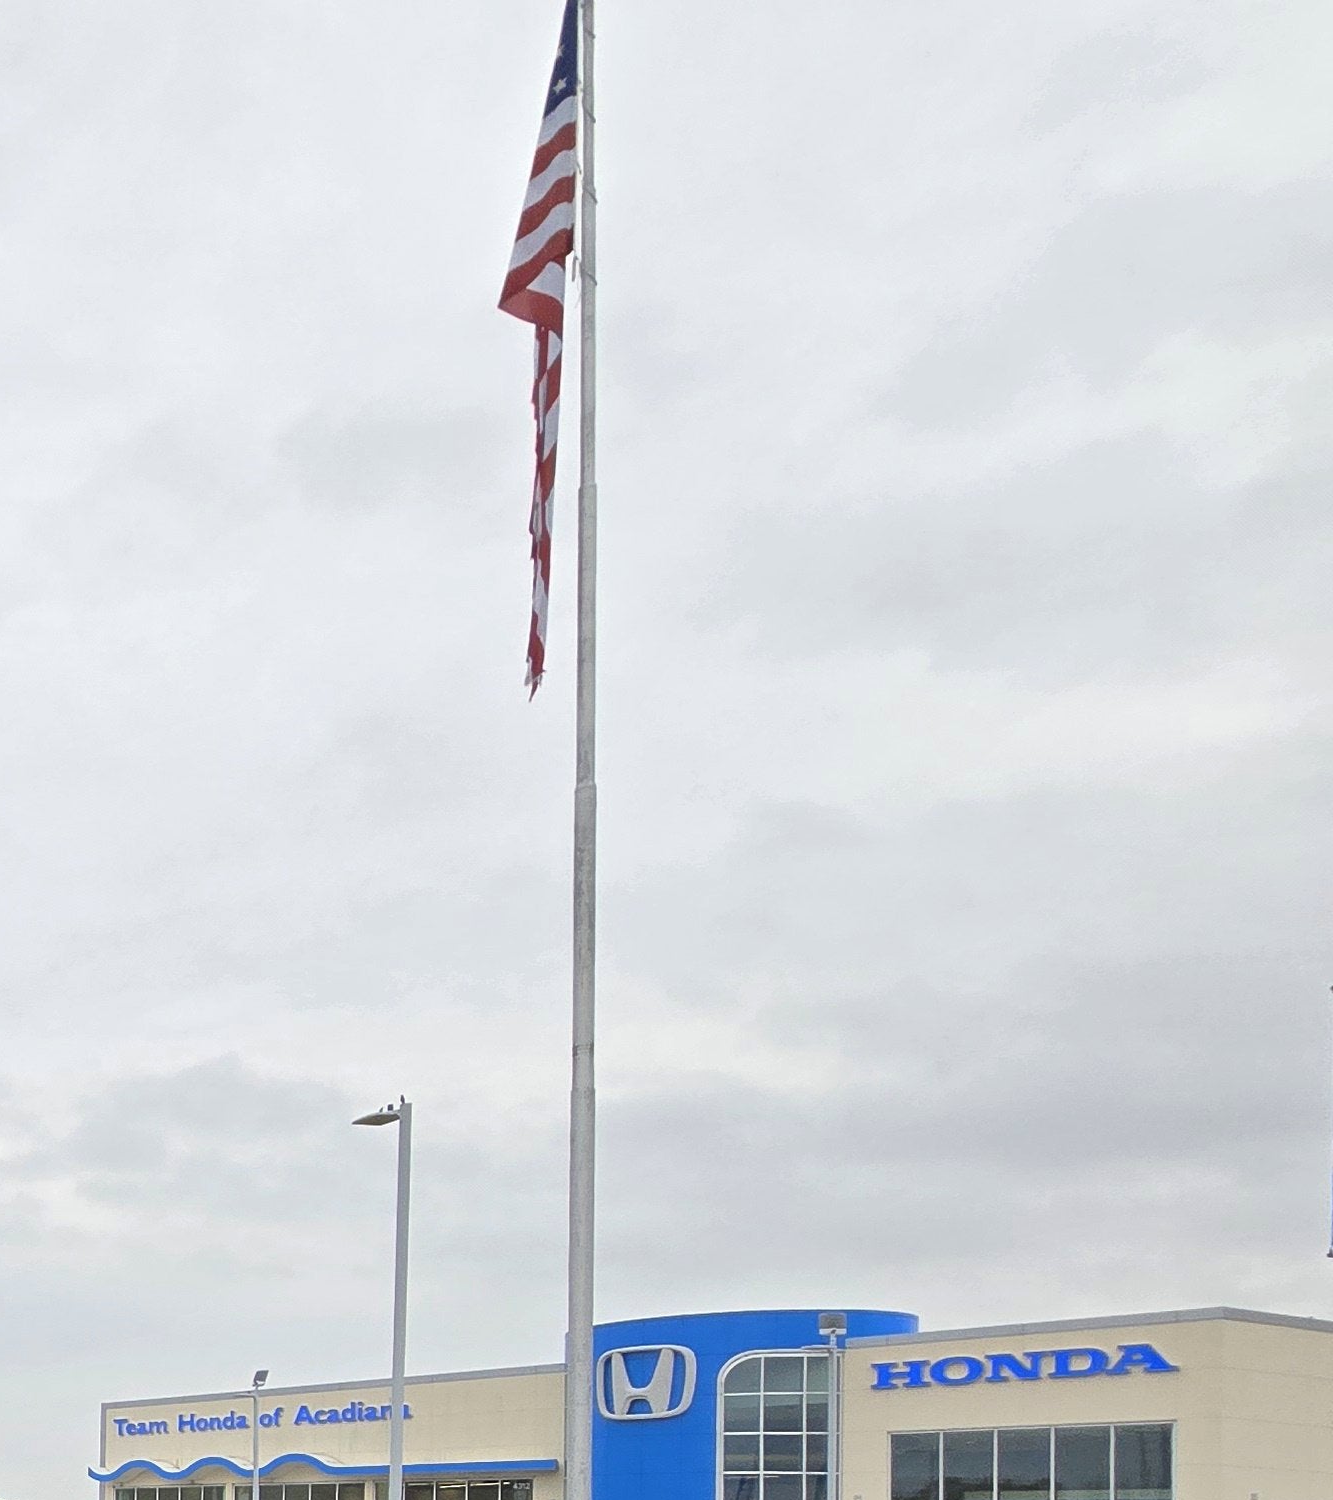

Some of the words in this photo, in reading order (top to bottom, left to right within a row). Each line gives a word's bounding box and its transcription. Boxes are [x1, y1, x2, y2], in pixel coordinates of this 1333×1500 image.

[871, 1343, 1179, 1390] HONDA
[113, 1418, 169, 1437] Team
[178, 1410, 250, 1433] Honda
[259, 1407, 284, 1428] of
